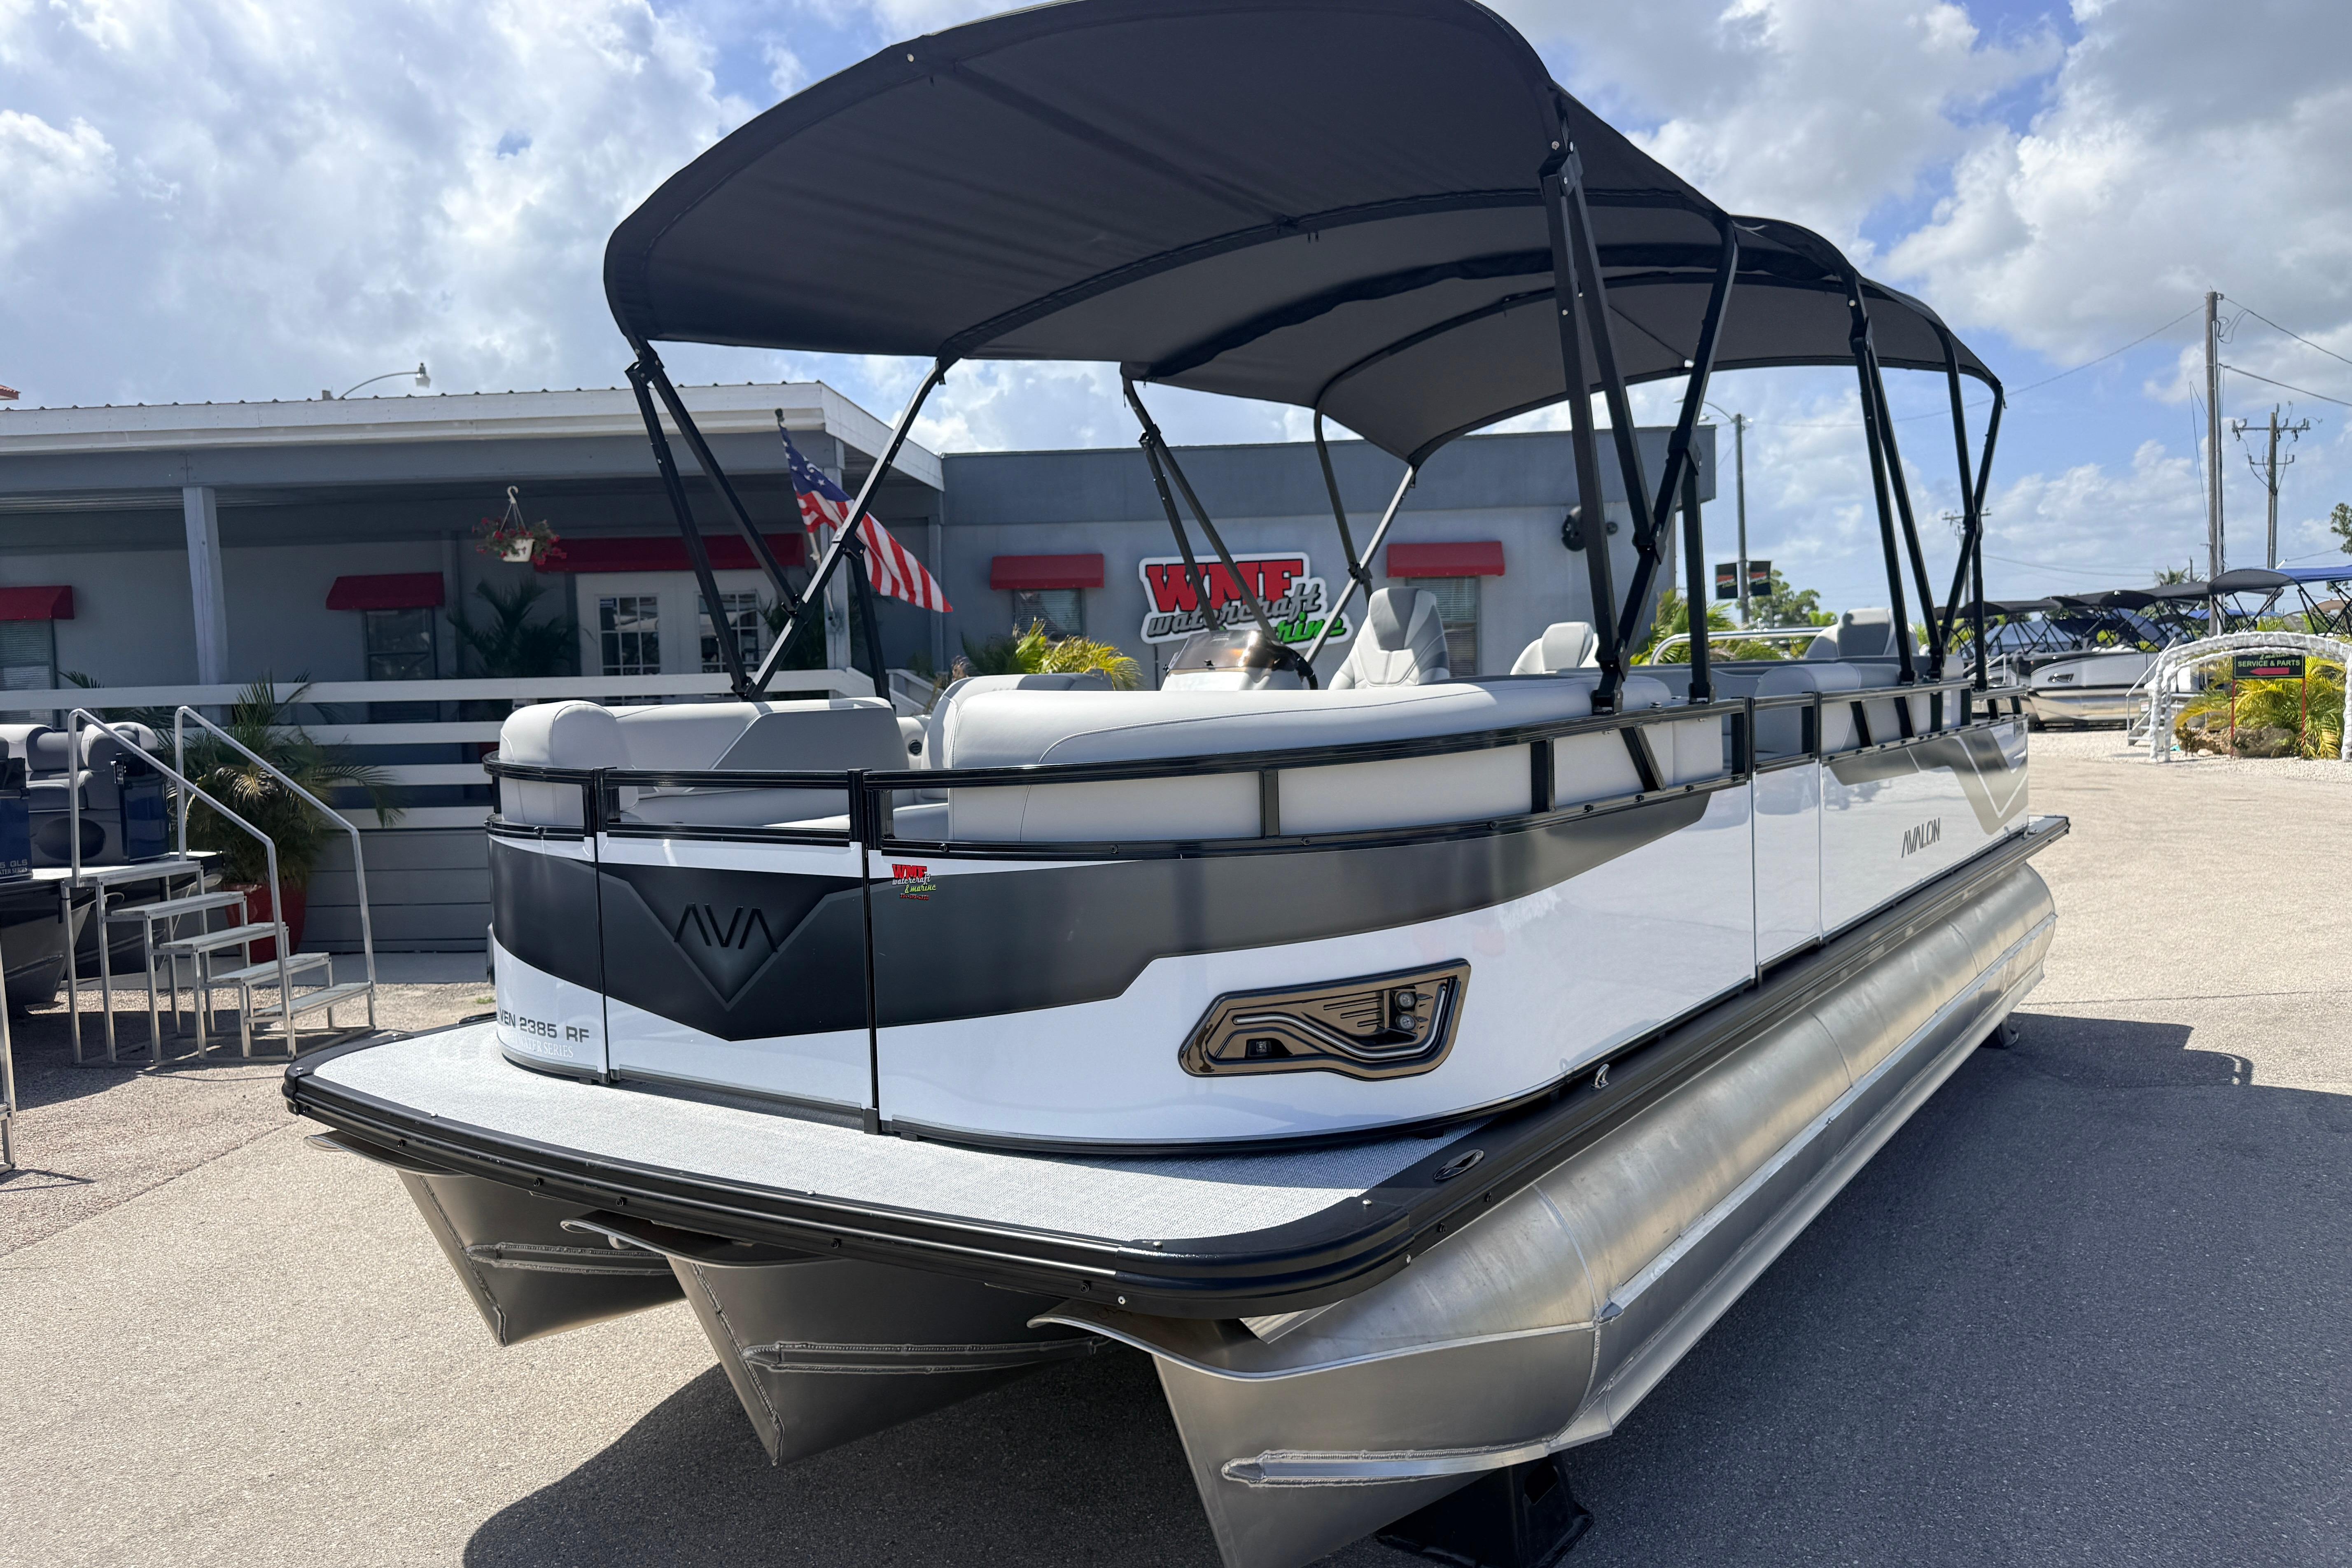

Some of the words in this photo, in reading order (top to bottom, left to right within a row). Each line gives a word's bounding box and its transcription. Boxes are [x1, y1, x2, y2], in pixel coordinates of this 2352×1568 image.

[1146, 559, 1303, 612] WMF
[1902, 817, 1940, 858] AVALON
[892, 864, 927, 879] WMF
[892, 873, 931, 885] watercraft
[905, 884, 910, 894] &
[910, 882, 936, 893] marine
[499, 1007, 516, 1028] VEN
[520, 1017, 558, 1038] 2385
[566, 1026, 589, 1043] RF
[544, 1042, 574, 1058] SERIES
